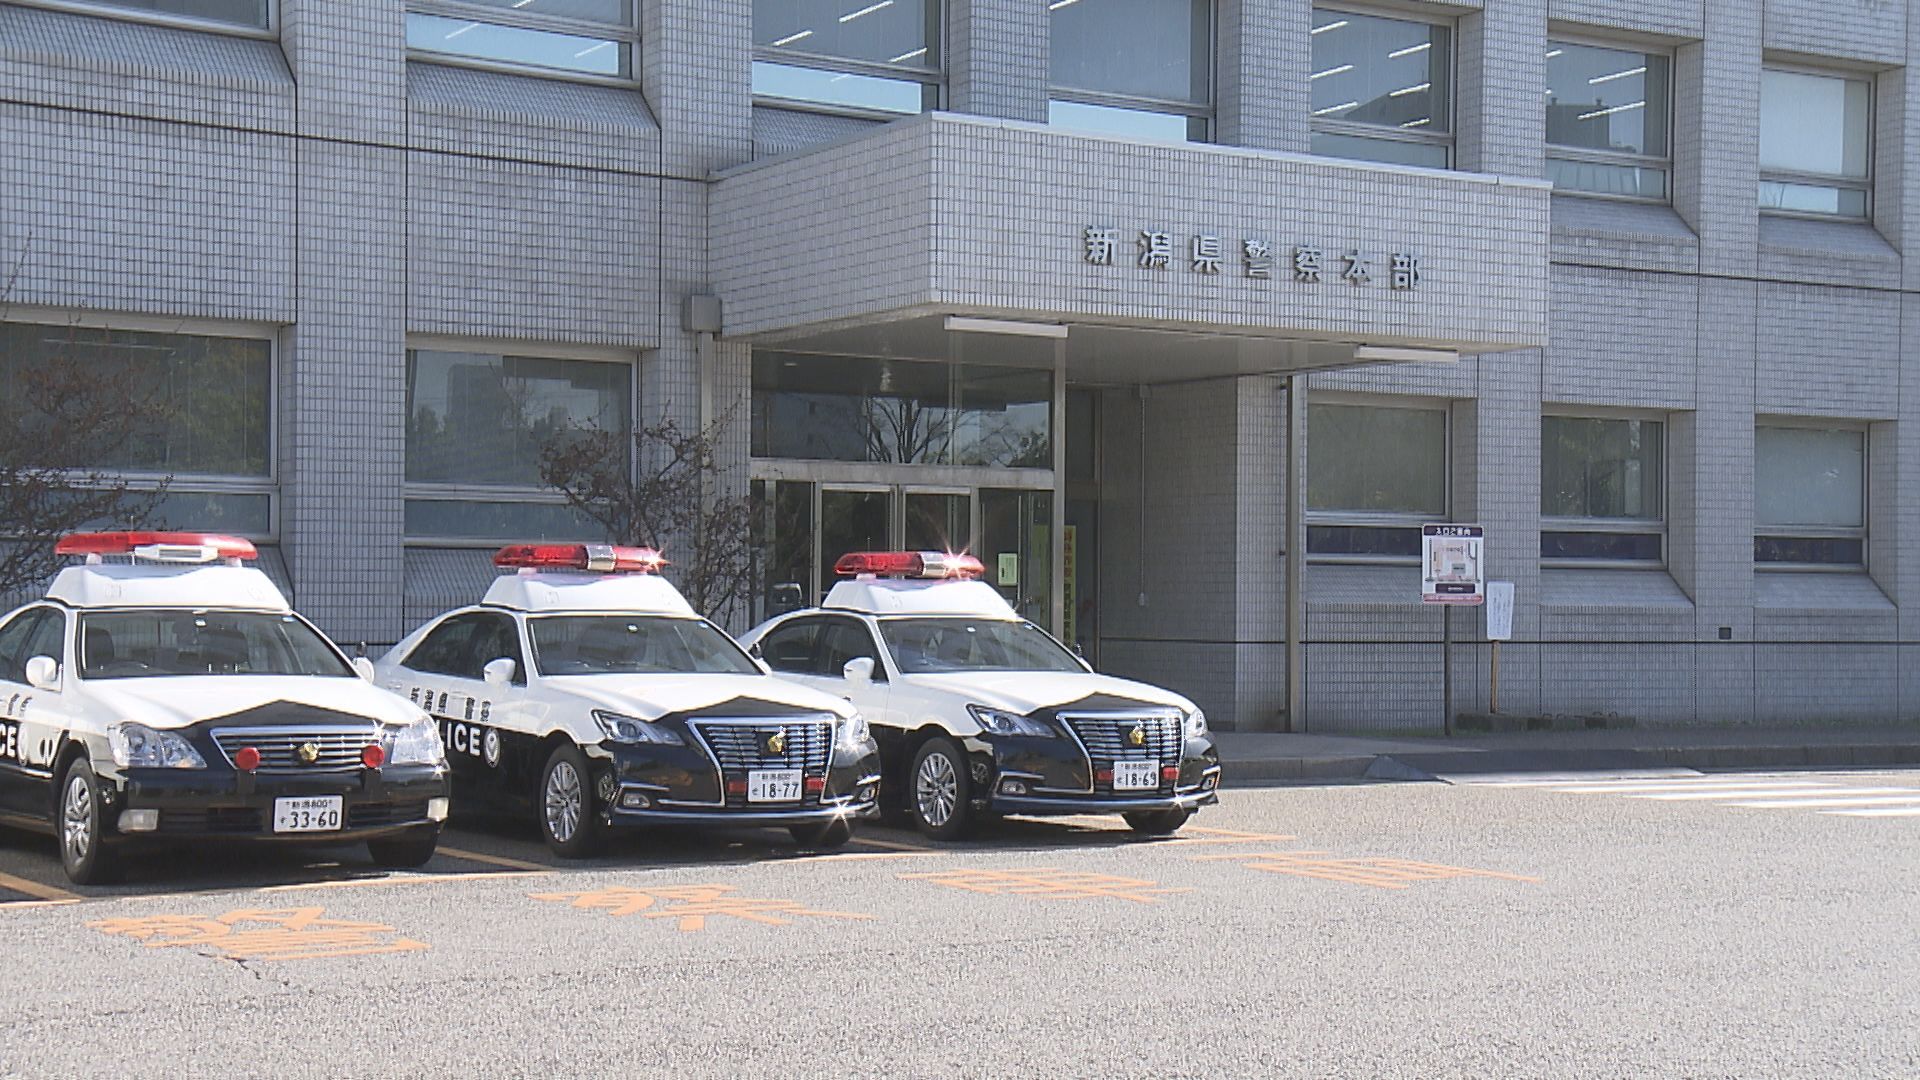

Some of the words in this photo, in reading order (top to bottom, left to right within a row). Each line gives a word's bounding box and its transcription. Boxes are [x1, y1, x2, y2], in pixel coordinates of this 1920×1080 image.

[1083, 225, 1420, 290] 新潟県警察本部
